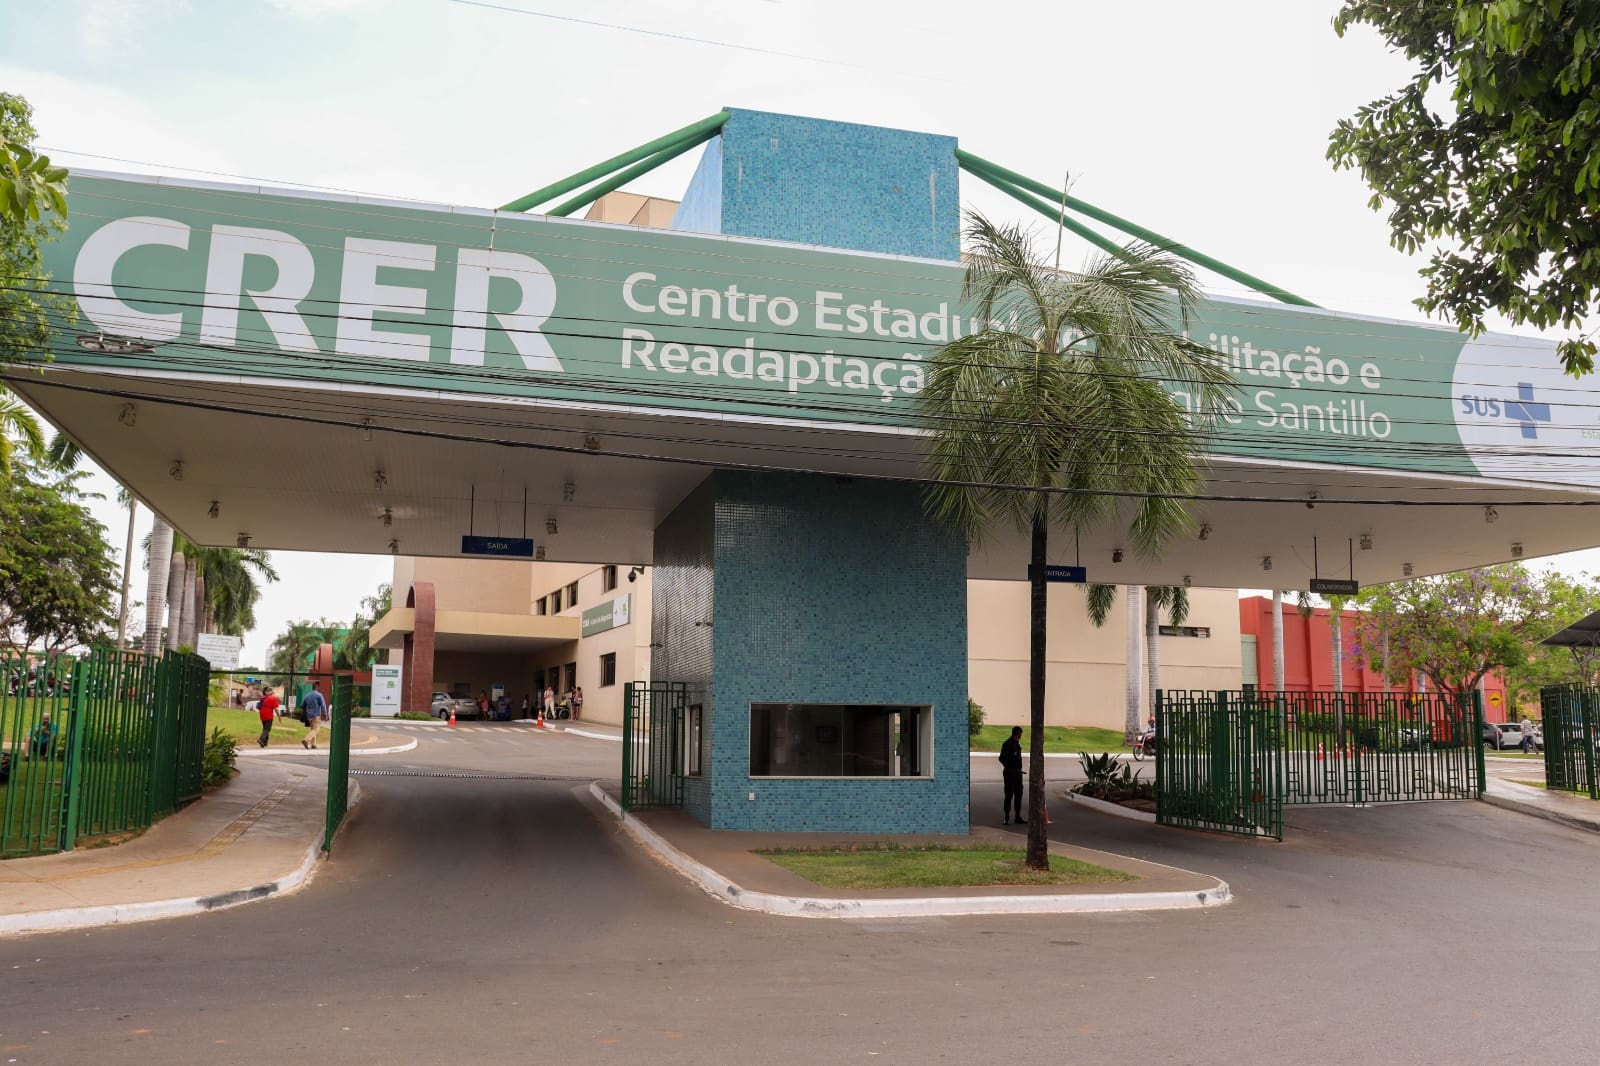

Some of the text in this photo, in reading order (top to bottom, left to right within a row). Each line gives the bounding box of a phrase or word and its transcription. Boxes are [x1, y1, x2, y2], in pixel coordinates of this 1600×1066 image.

[73, 215, 565, 373] CRER
[622, 271, 799, 327] Centro
[1181, 331, 1350, 388] ilitação
[1359, 362, 1381, 389] e
[621, 328, 938, 402] Readaptaçã
[1255, 390, 1392, 439] Santillo
[1461, 394, 1500, 418] SUS
[1047, 569, 1071, 577] NTRADA
